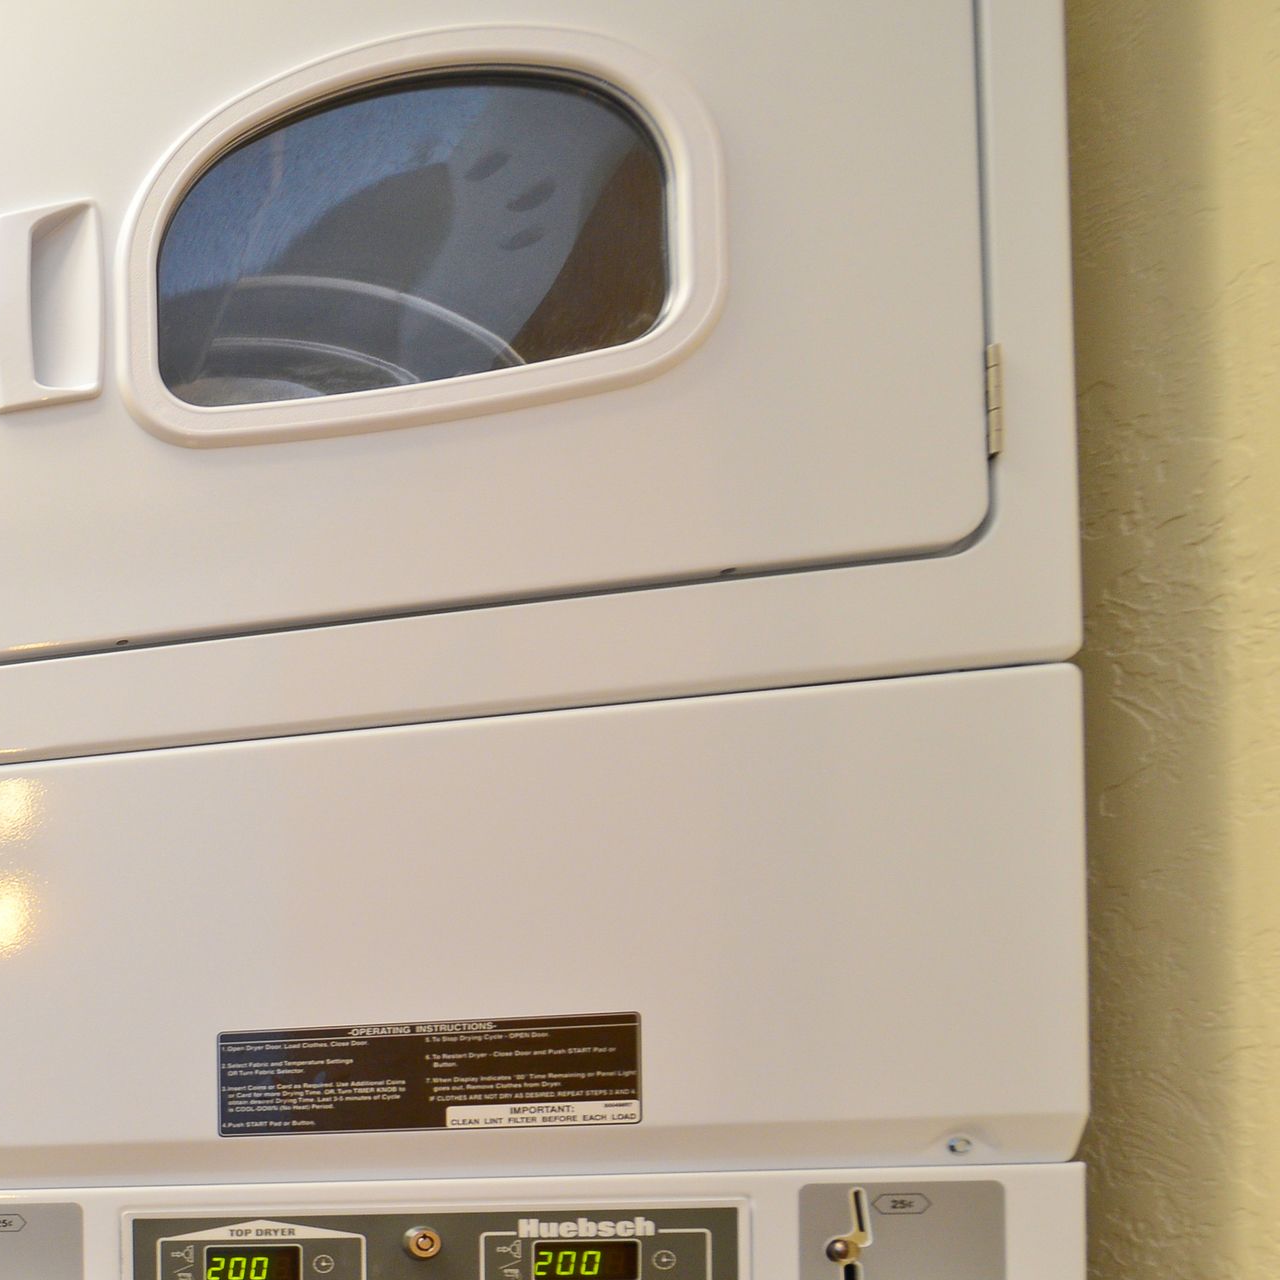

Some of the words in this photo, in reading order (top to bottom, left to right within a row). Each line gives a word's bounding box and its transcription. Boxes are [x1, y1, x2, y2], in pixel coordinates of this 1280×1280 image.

[510, 1104, 575, 1114] IMPORTANT:
[450, 1118, 480, 1126] CLEAN
[542, 1114, 578, 1122] BEFORE
[583, 1113, 607, 1121] EACH
[612, 1112, 637, 1120] LOAD
[229, 1228, 252, 1237] TOP
[255, 1228, 296, 1237] DRYER
[518, 1216, 656, 1238] Huebsch
[207, 1256, 269, 1280] 200
[534, 1250, 601, 1275] 200
